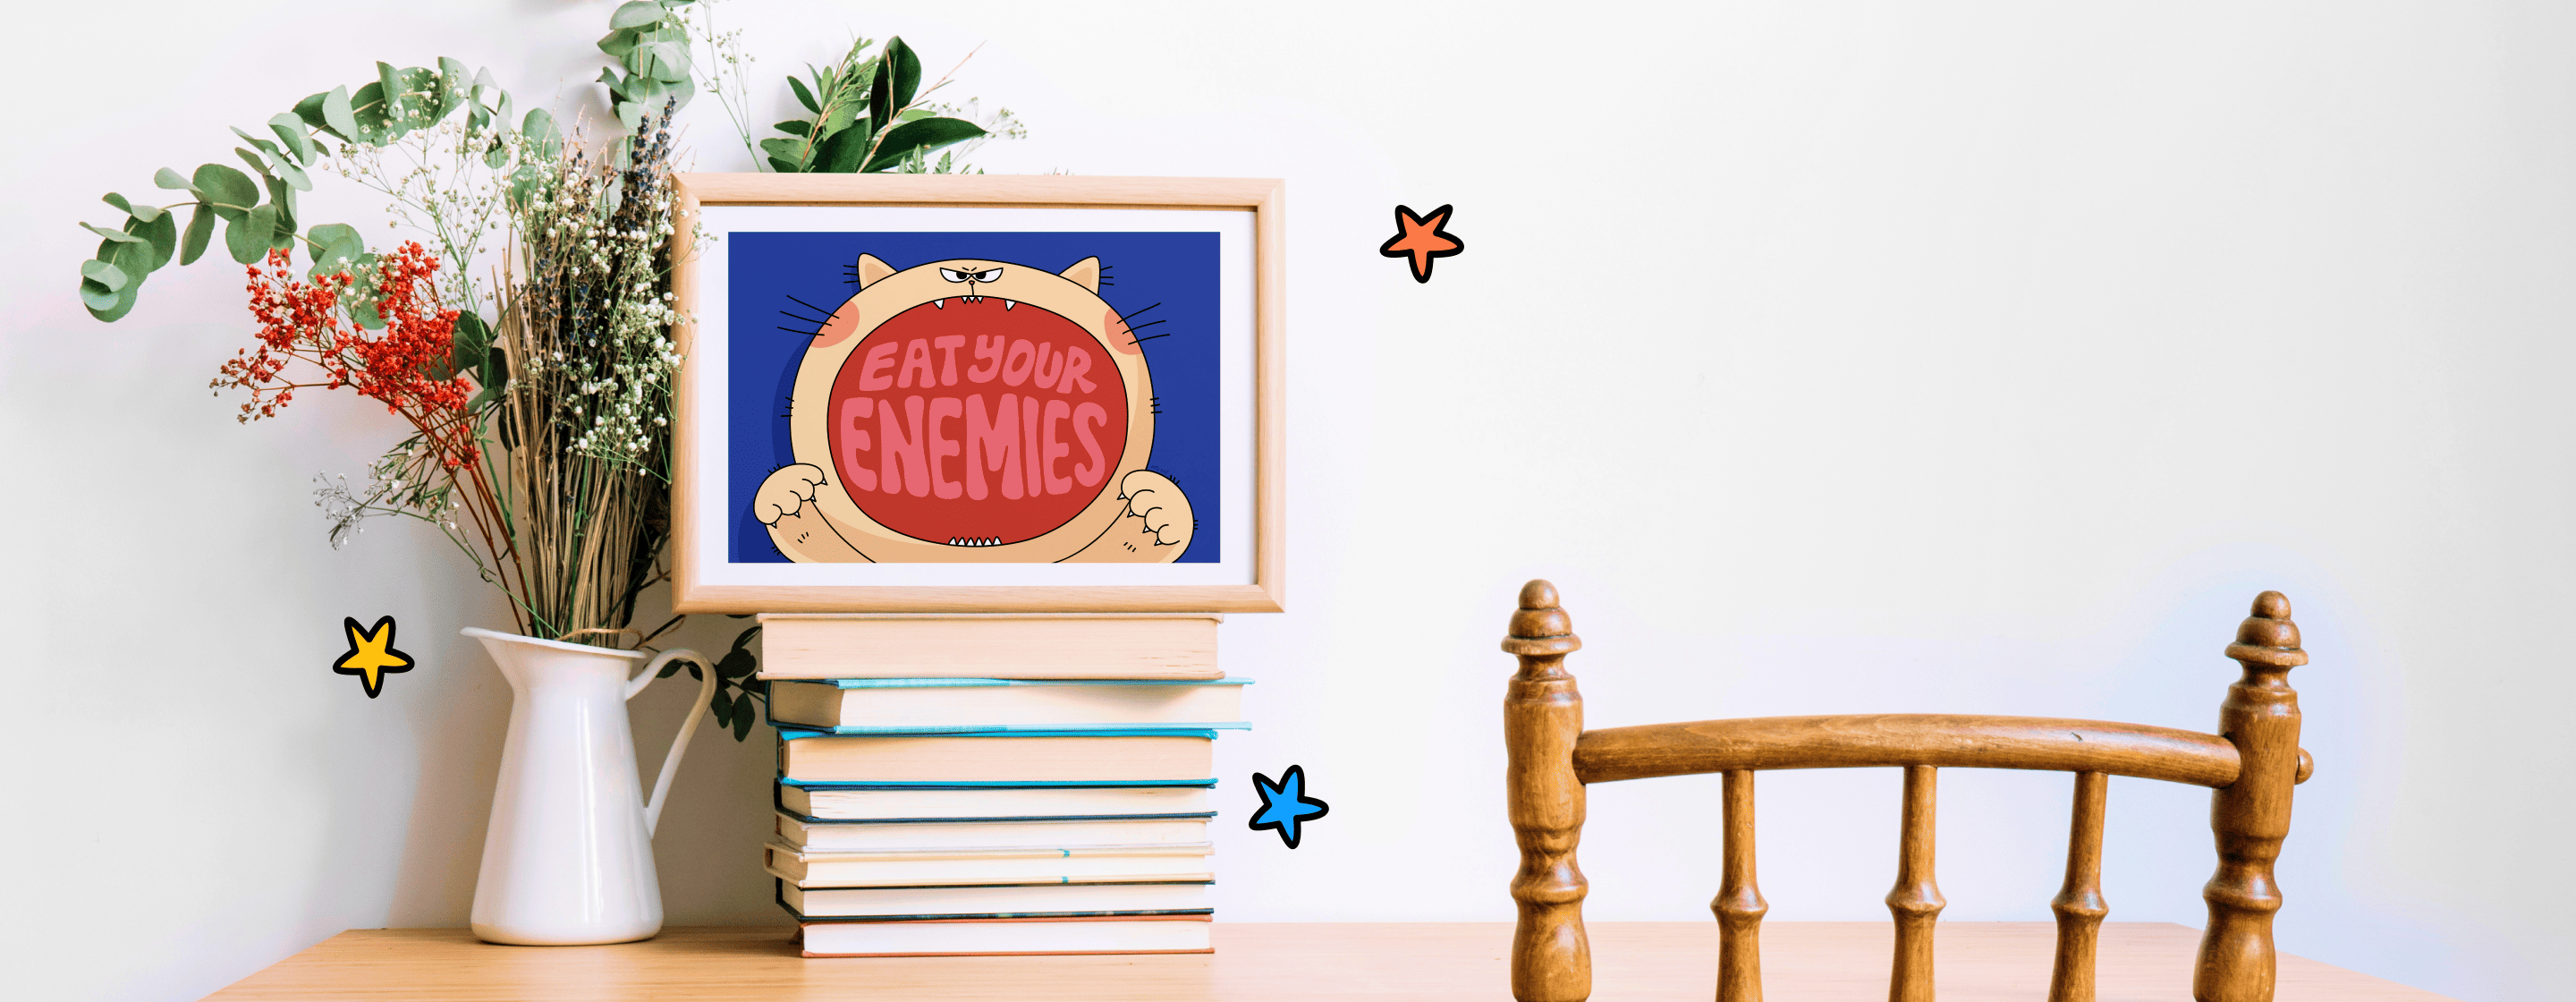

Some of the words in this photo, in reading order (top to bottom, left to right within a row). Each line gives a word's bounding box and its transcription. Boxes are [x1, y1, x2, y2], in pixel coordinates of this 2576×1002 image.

[859, 335, 966, 392] EAT
[967, 334, 1097, 395] YOUR
[840, 394, 1107, 501] ENEMIES
